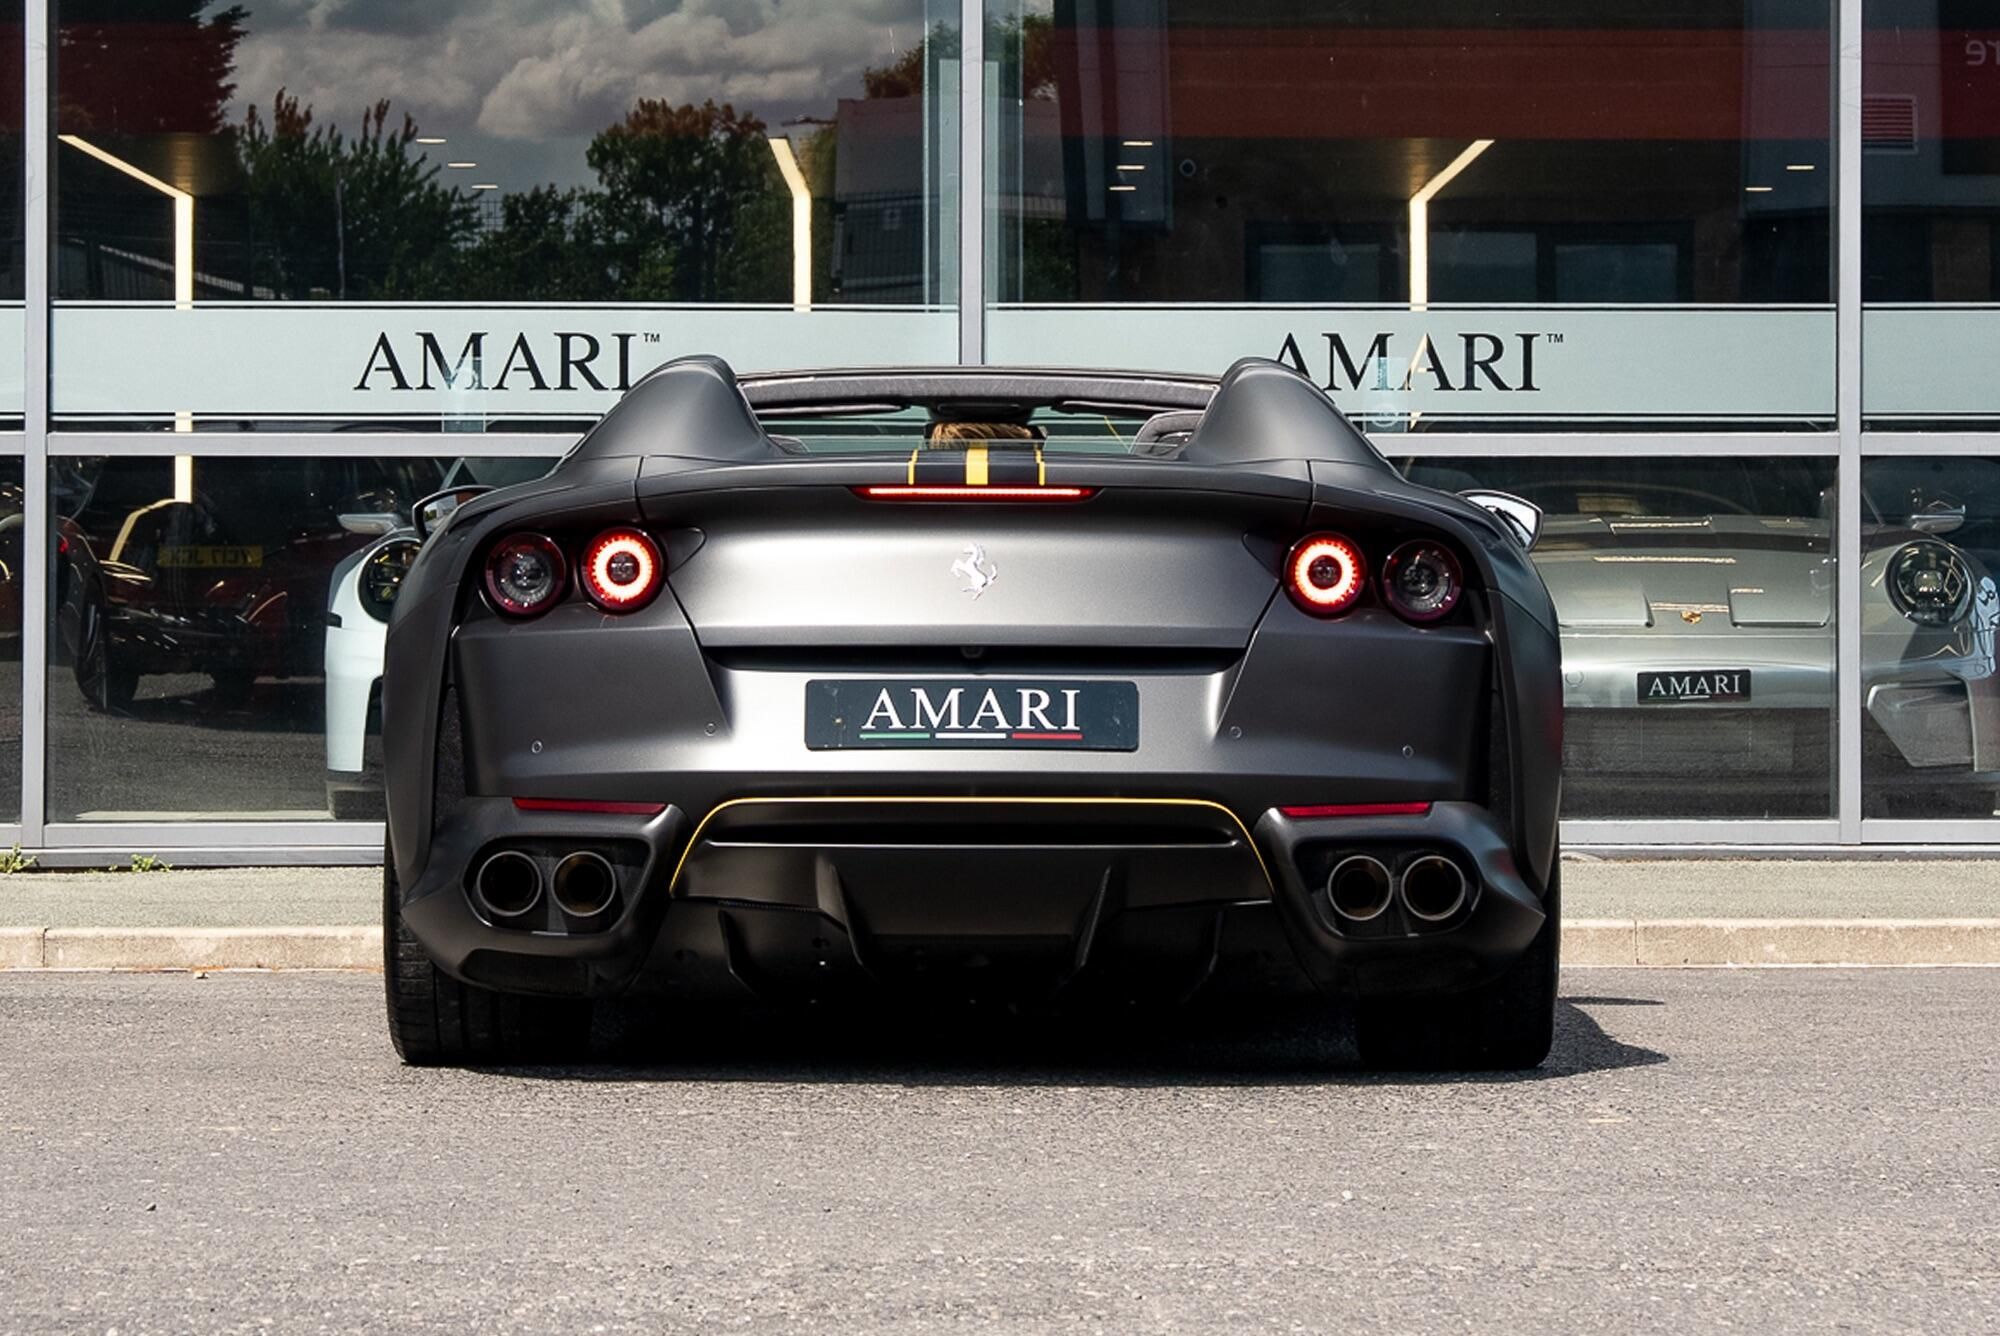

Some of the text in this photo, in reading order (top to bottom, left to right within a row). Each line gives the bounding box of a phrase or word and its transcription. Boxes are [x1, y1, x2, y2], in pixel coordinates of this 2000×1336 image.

[353, 331, 637, 391] AMARI
[1648, 674, 1741, 696] AMARI
[860, 687, 1081, 731] AMARI
